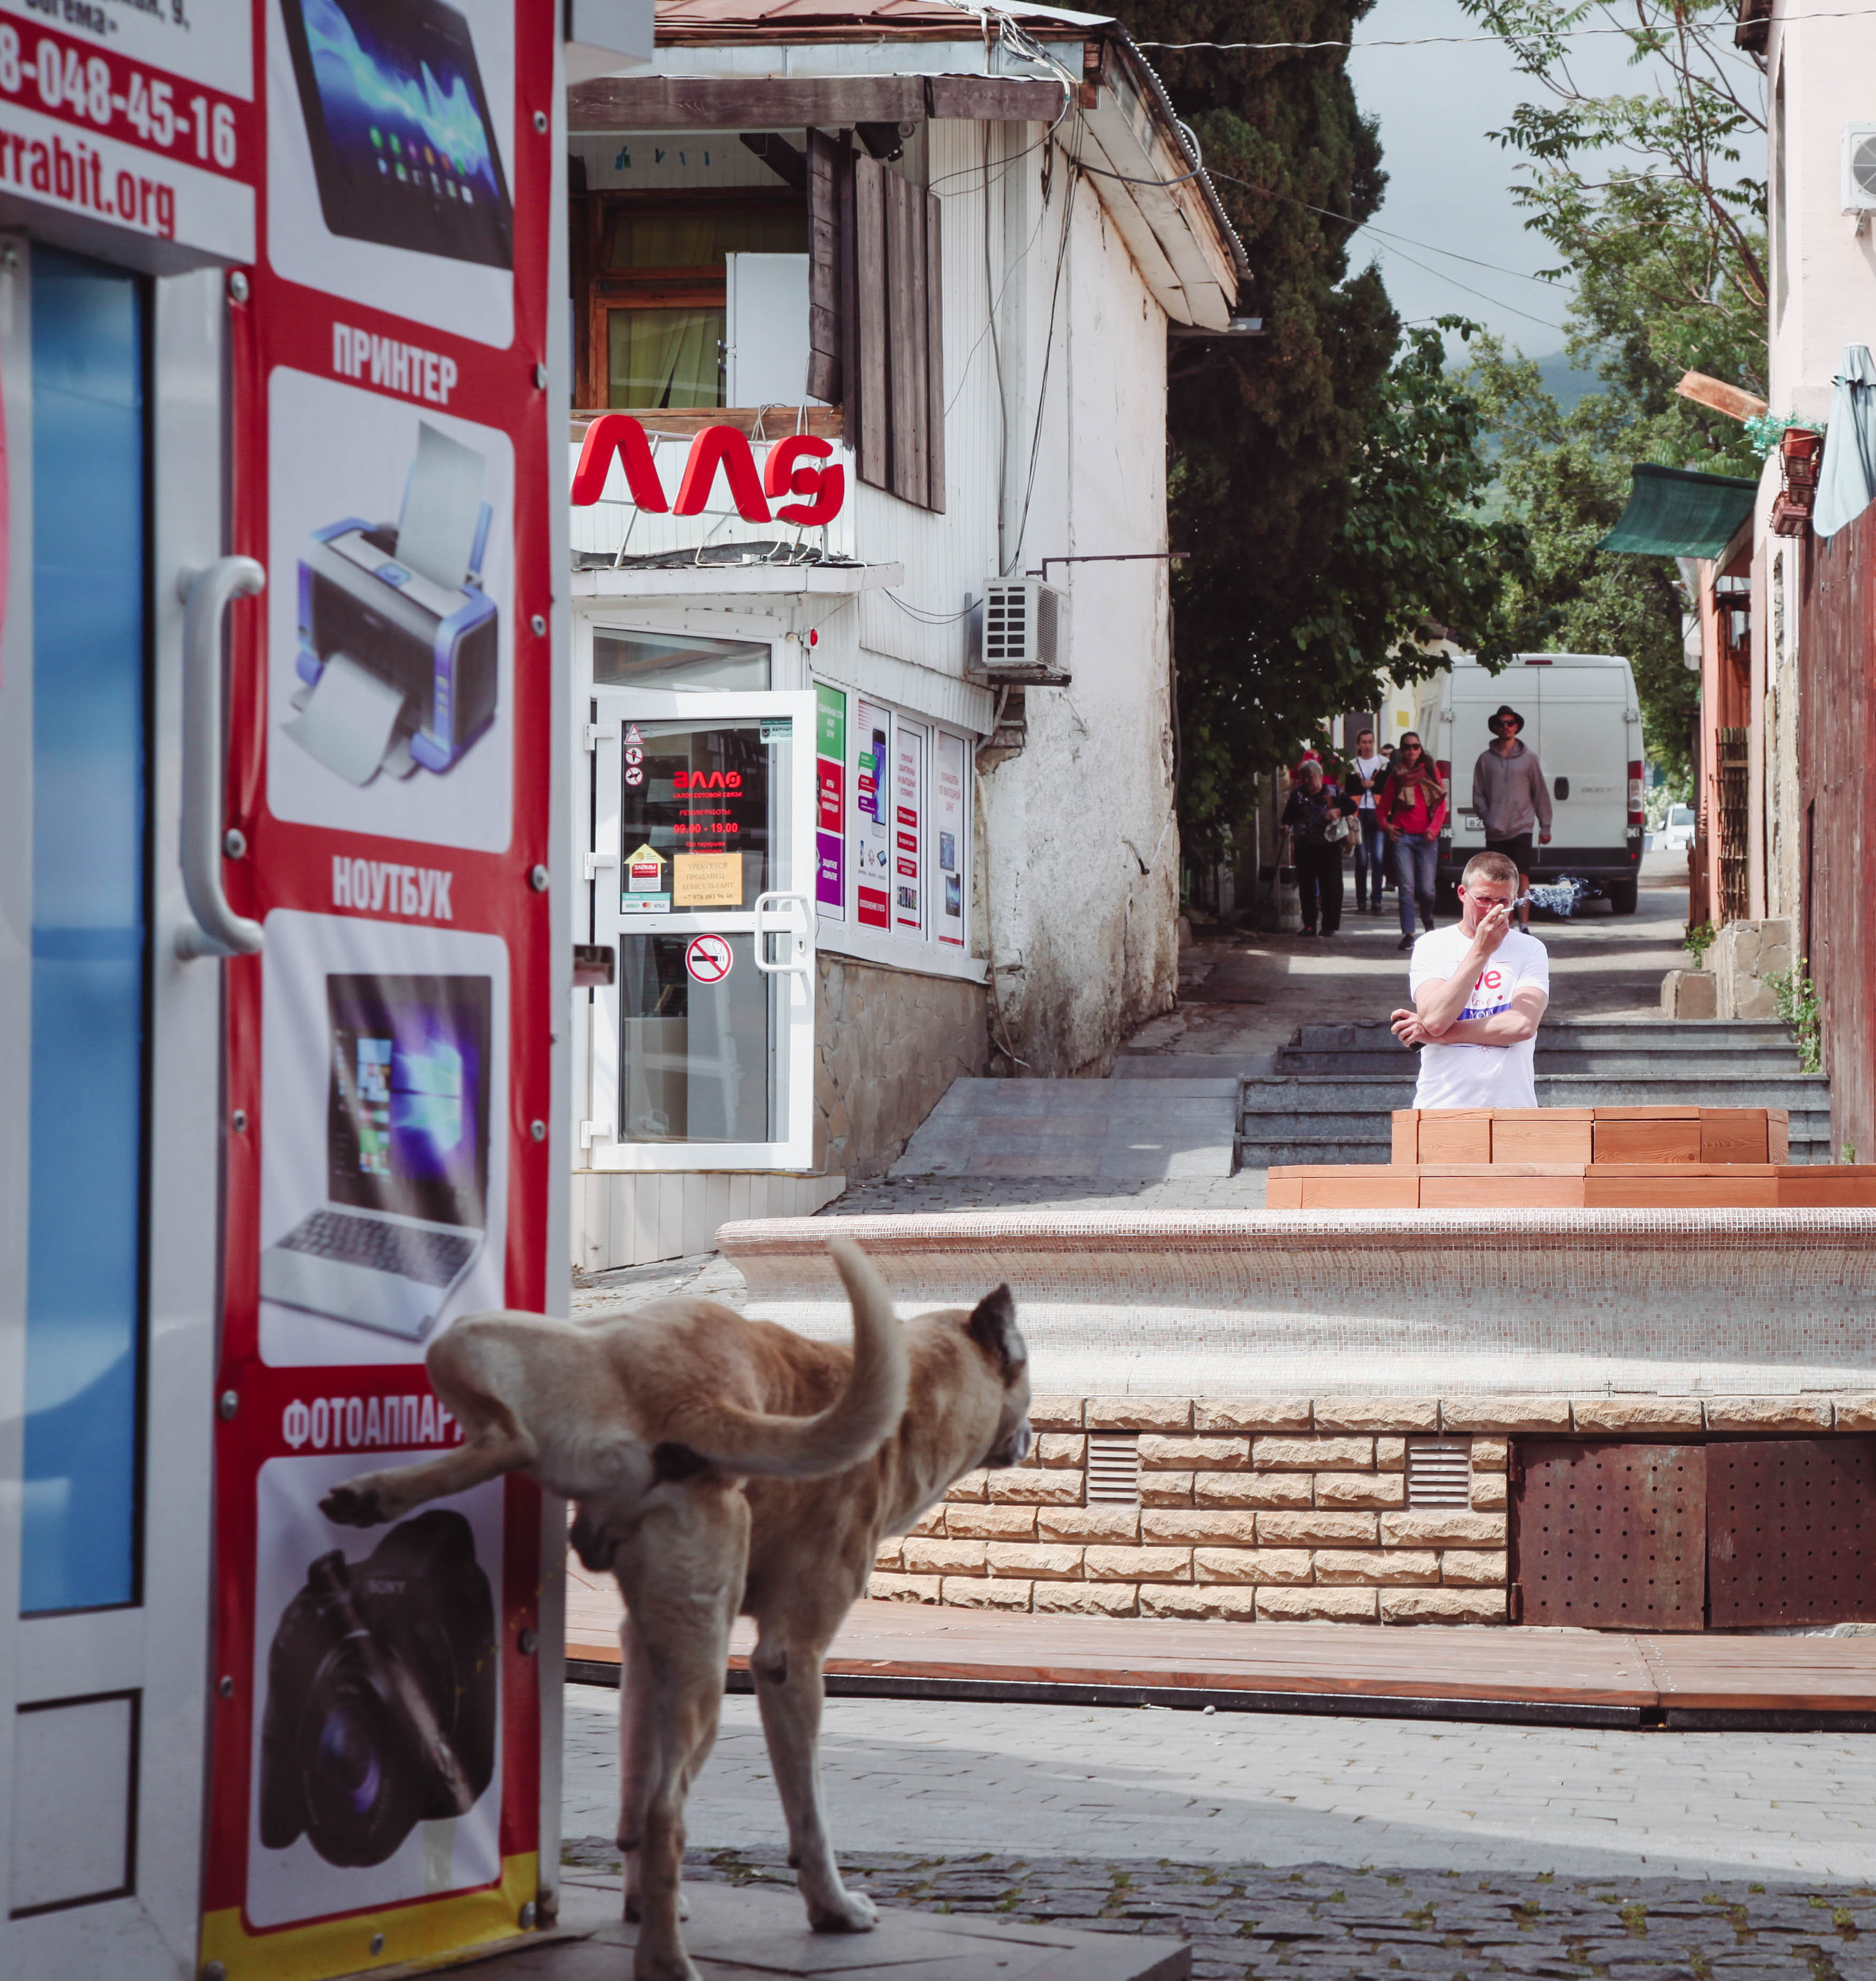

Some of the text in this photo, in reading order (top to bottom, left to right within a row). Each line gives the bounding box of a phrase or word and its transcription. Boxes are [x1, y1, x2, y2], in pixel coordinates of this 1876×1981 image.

[333, 321, 458, 405] ПРИНТЕР
[673, 823, 702, 834] 09.00
[710, 822, 739, 833] 19.00
[687, 862, 728, 871] ТРЕБУЕТСЯ
[332, 855, 453, 921] НОУТБУК
[682, 882, 734, 890] КОНСУЛЬТАНТ
[1471, 992, 1492, 1007] love
[282, 1395, 465, 1450] ФОТОАППАР
